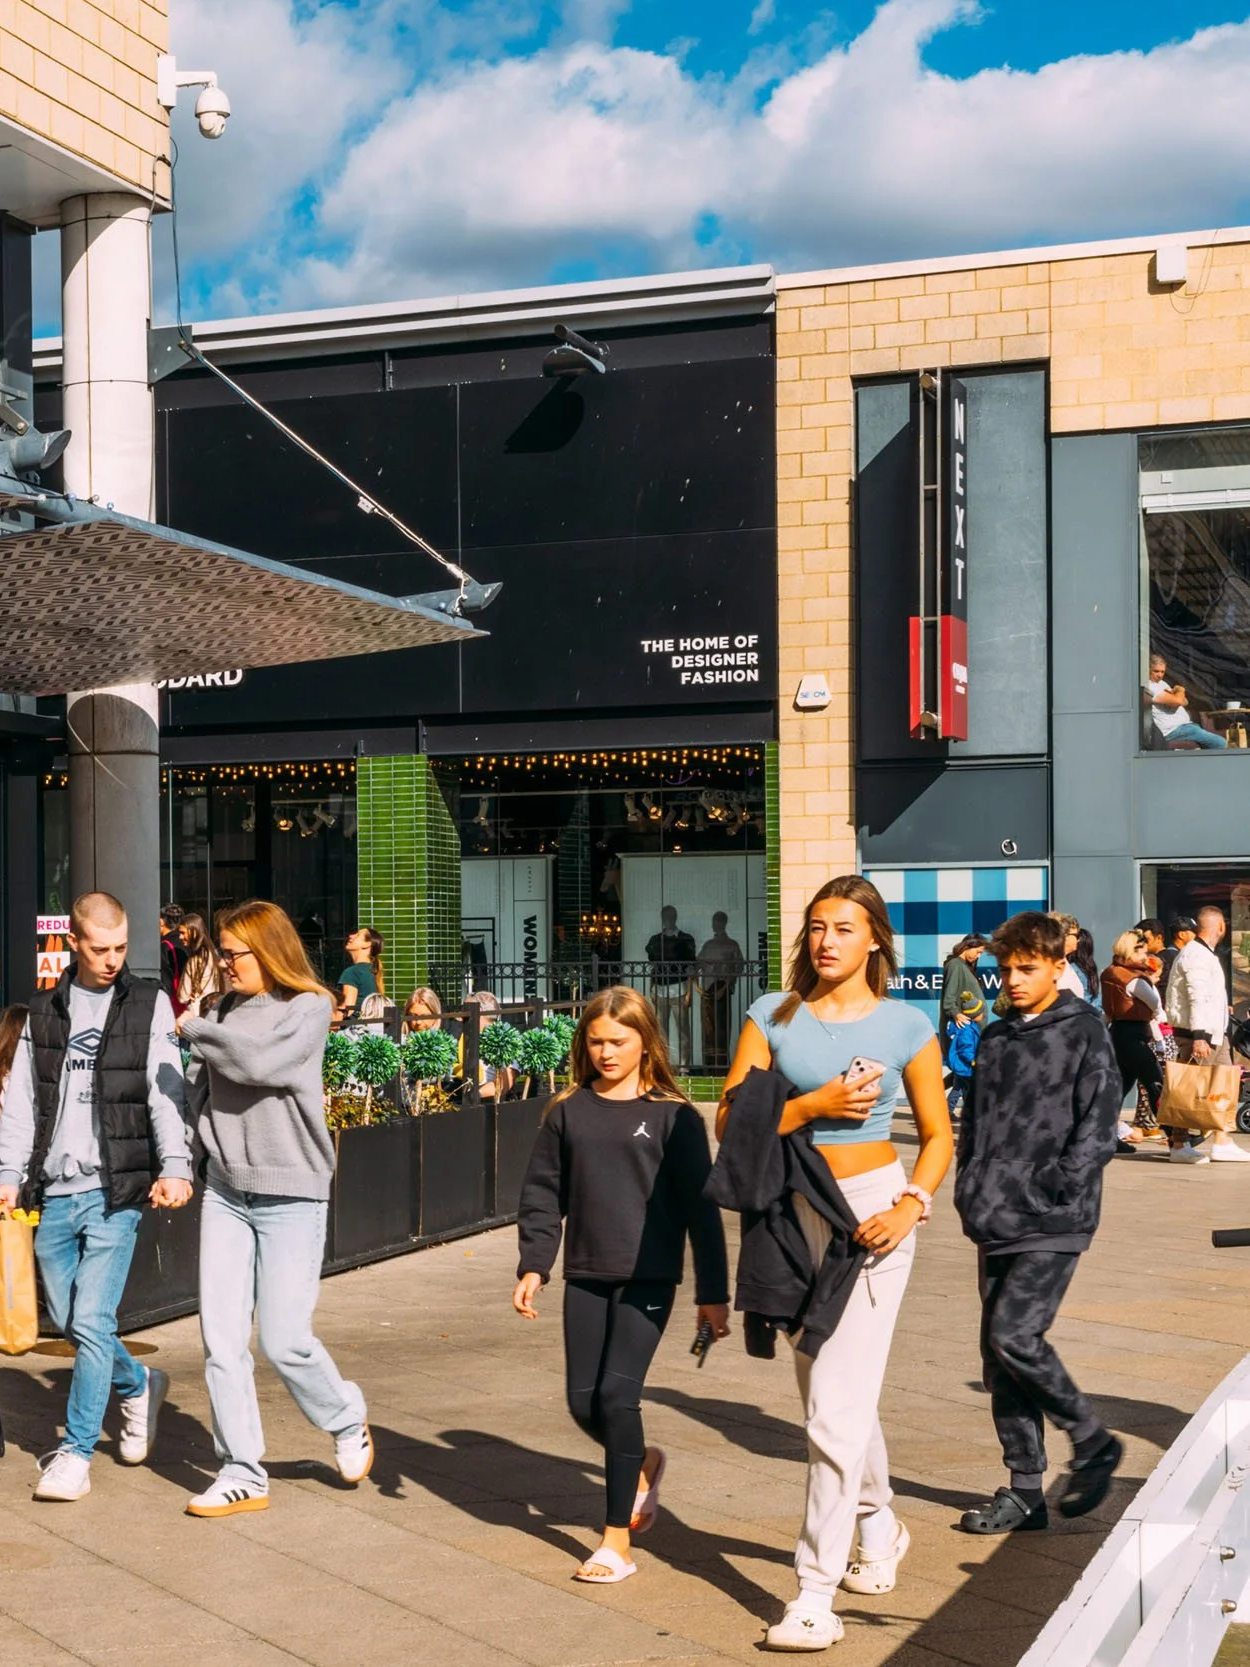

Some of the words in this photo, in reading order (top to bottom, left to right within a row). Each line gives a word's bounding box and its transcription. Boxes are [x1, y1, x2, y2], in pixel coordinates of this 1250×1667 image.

[954, 397, 965, 600] NEXT
[641, 639, 675, 653] THE
[679, 636, 730, 651] HOME
[734, 635, 759, 648] OF
[671, 652, 759, 669] DESIGNER
[681, 669, 759, 685] FASHION
